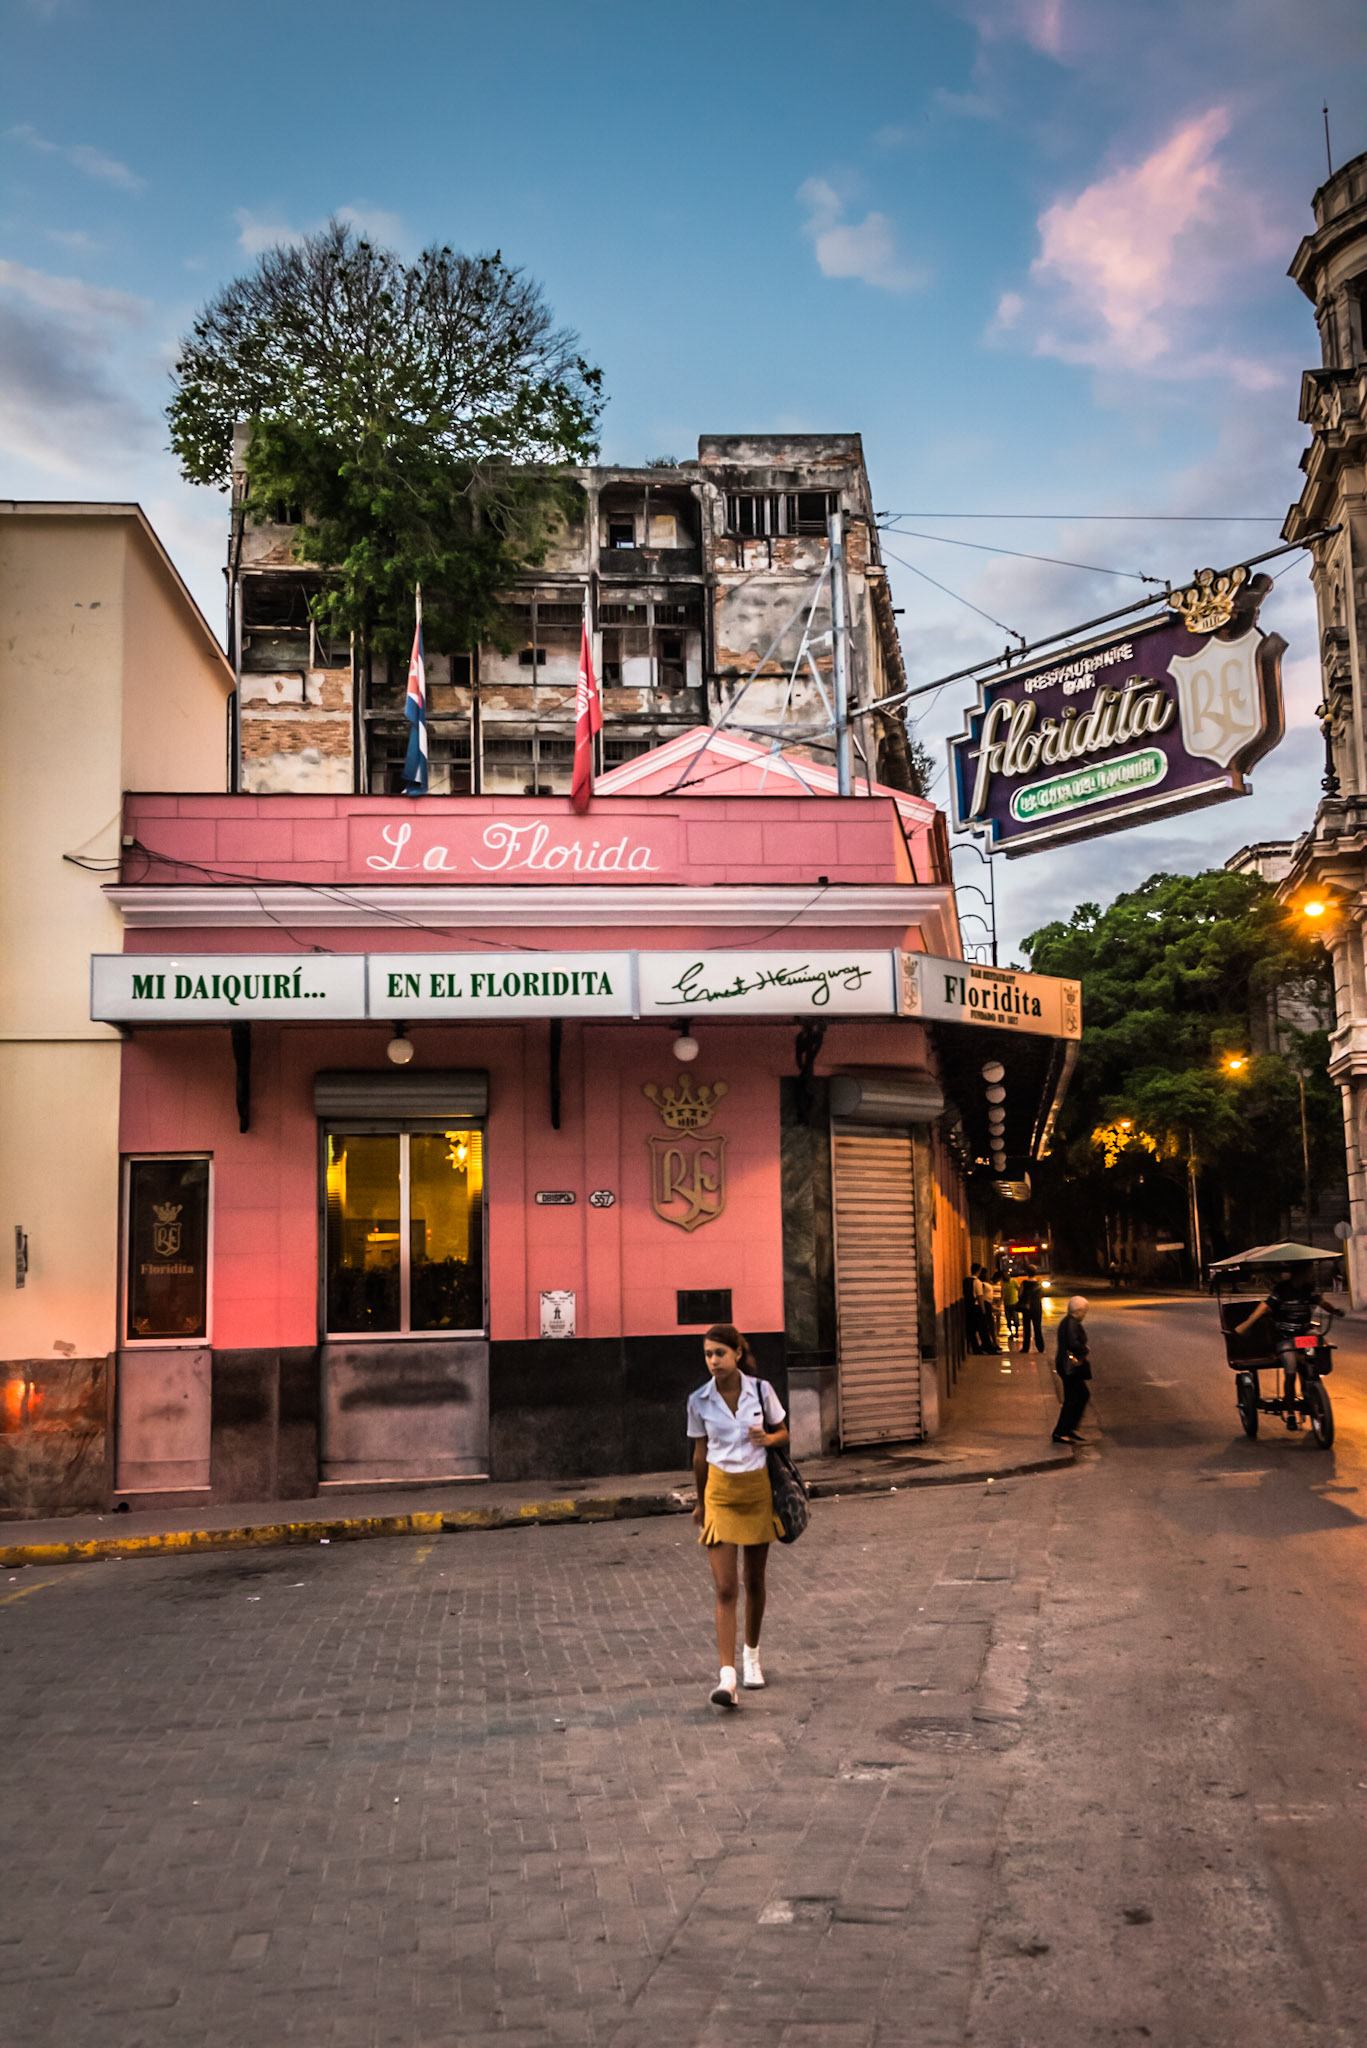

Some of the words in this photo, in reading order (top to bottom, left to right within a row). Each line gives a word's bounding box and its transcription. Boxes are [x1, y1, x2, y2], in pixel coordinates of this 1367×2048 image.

[1063, 673, 1096, 697] BAR
[366, 823, 457, 871] La
[471, 820, 661, 871] Florida
[132, 975, 165, 999] MI
[174, 966, 326, 1006] DAIQUIRÍ...
[387, 973, 421, 998] EN
[429, 973, 462, 998] EL
[470, 971, 614, 997] FLORIDITA
[943, 975, 1042, 1017] Floridita
[140, 1263, 194, 1275] Floridita
